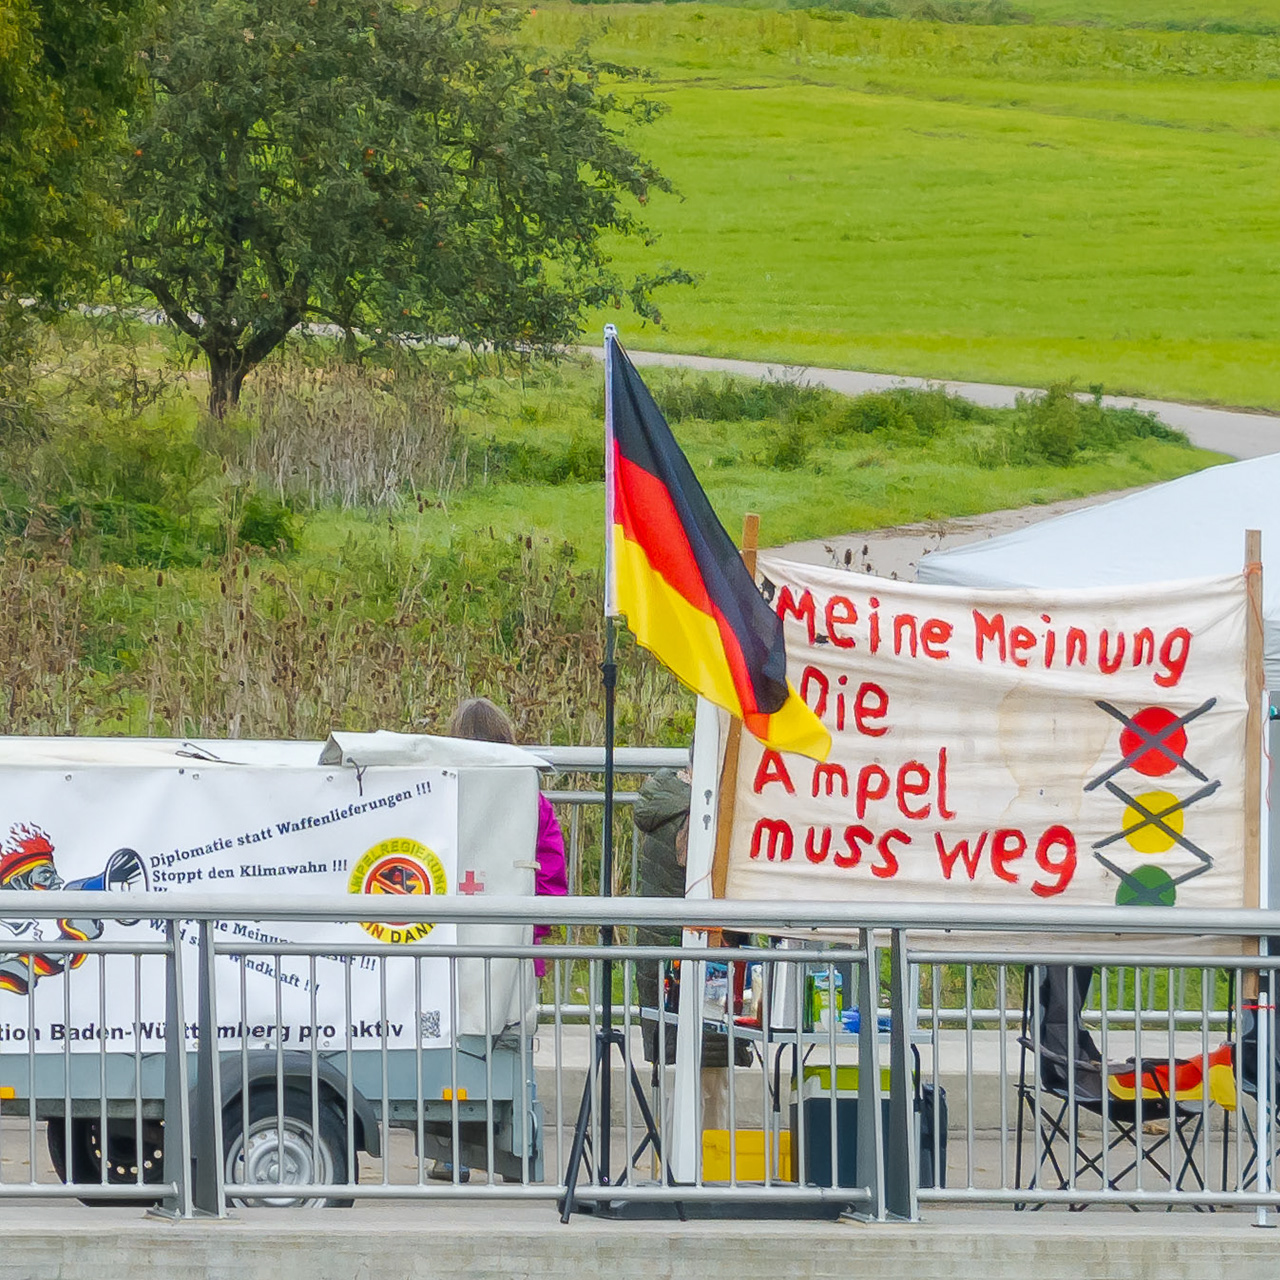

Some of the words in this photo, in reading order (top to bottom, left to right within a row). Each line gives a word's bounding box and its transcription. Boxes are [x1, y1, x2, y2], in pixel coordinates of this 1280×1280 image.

[776, 586, 953, 660] Meine
[973, 610, 1192, 687] Meinung
[800, 665, 888, 736] Die
[753, 747, 956, 820] Ampel
[150, 837, 233, 869] Diplomatie
[237, 827, 273, 846] statt
[276, 789, 413, 835] Waffenlieferungen
[750, 817, 912, 879] muss
[934, 824, 1078, 898] weg
[152, 867, 203, 884] Stoppt
[208, 864, 234, 879] den
[240, 861, 328, 877] Klimawahn
[229, 954, 301, 988] Wndkaft
[51, 1020, 290, 1042] Baden-Wüttmberg
[300, 1025, 335, 1042] pro
[346, 1020, 403, 1038] aktiv
